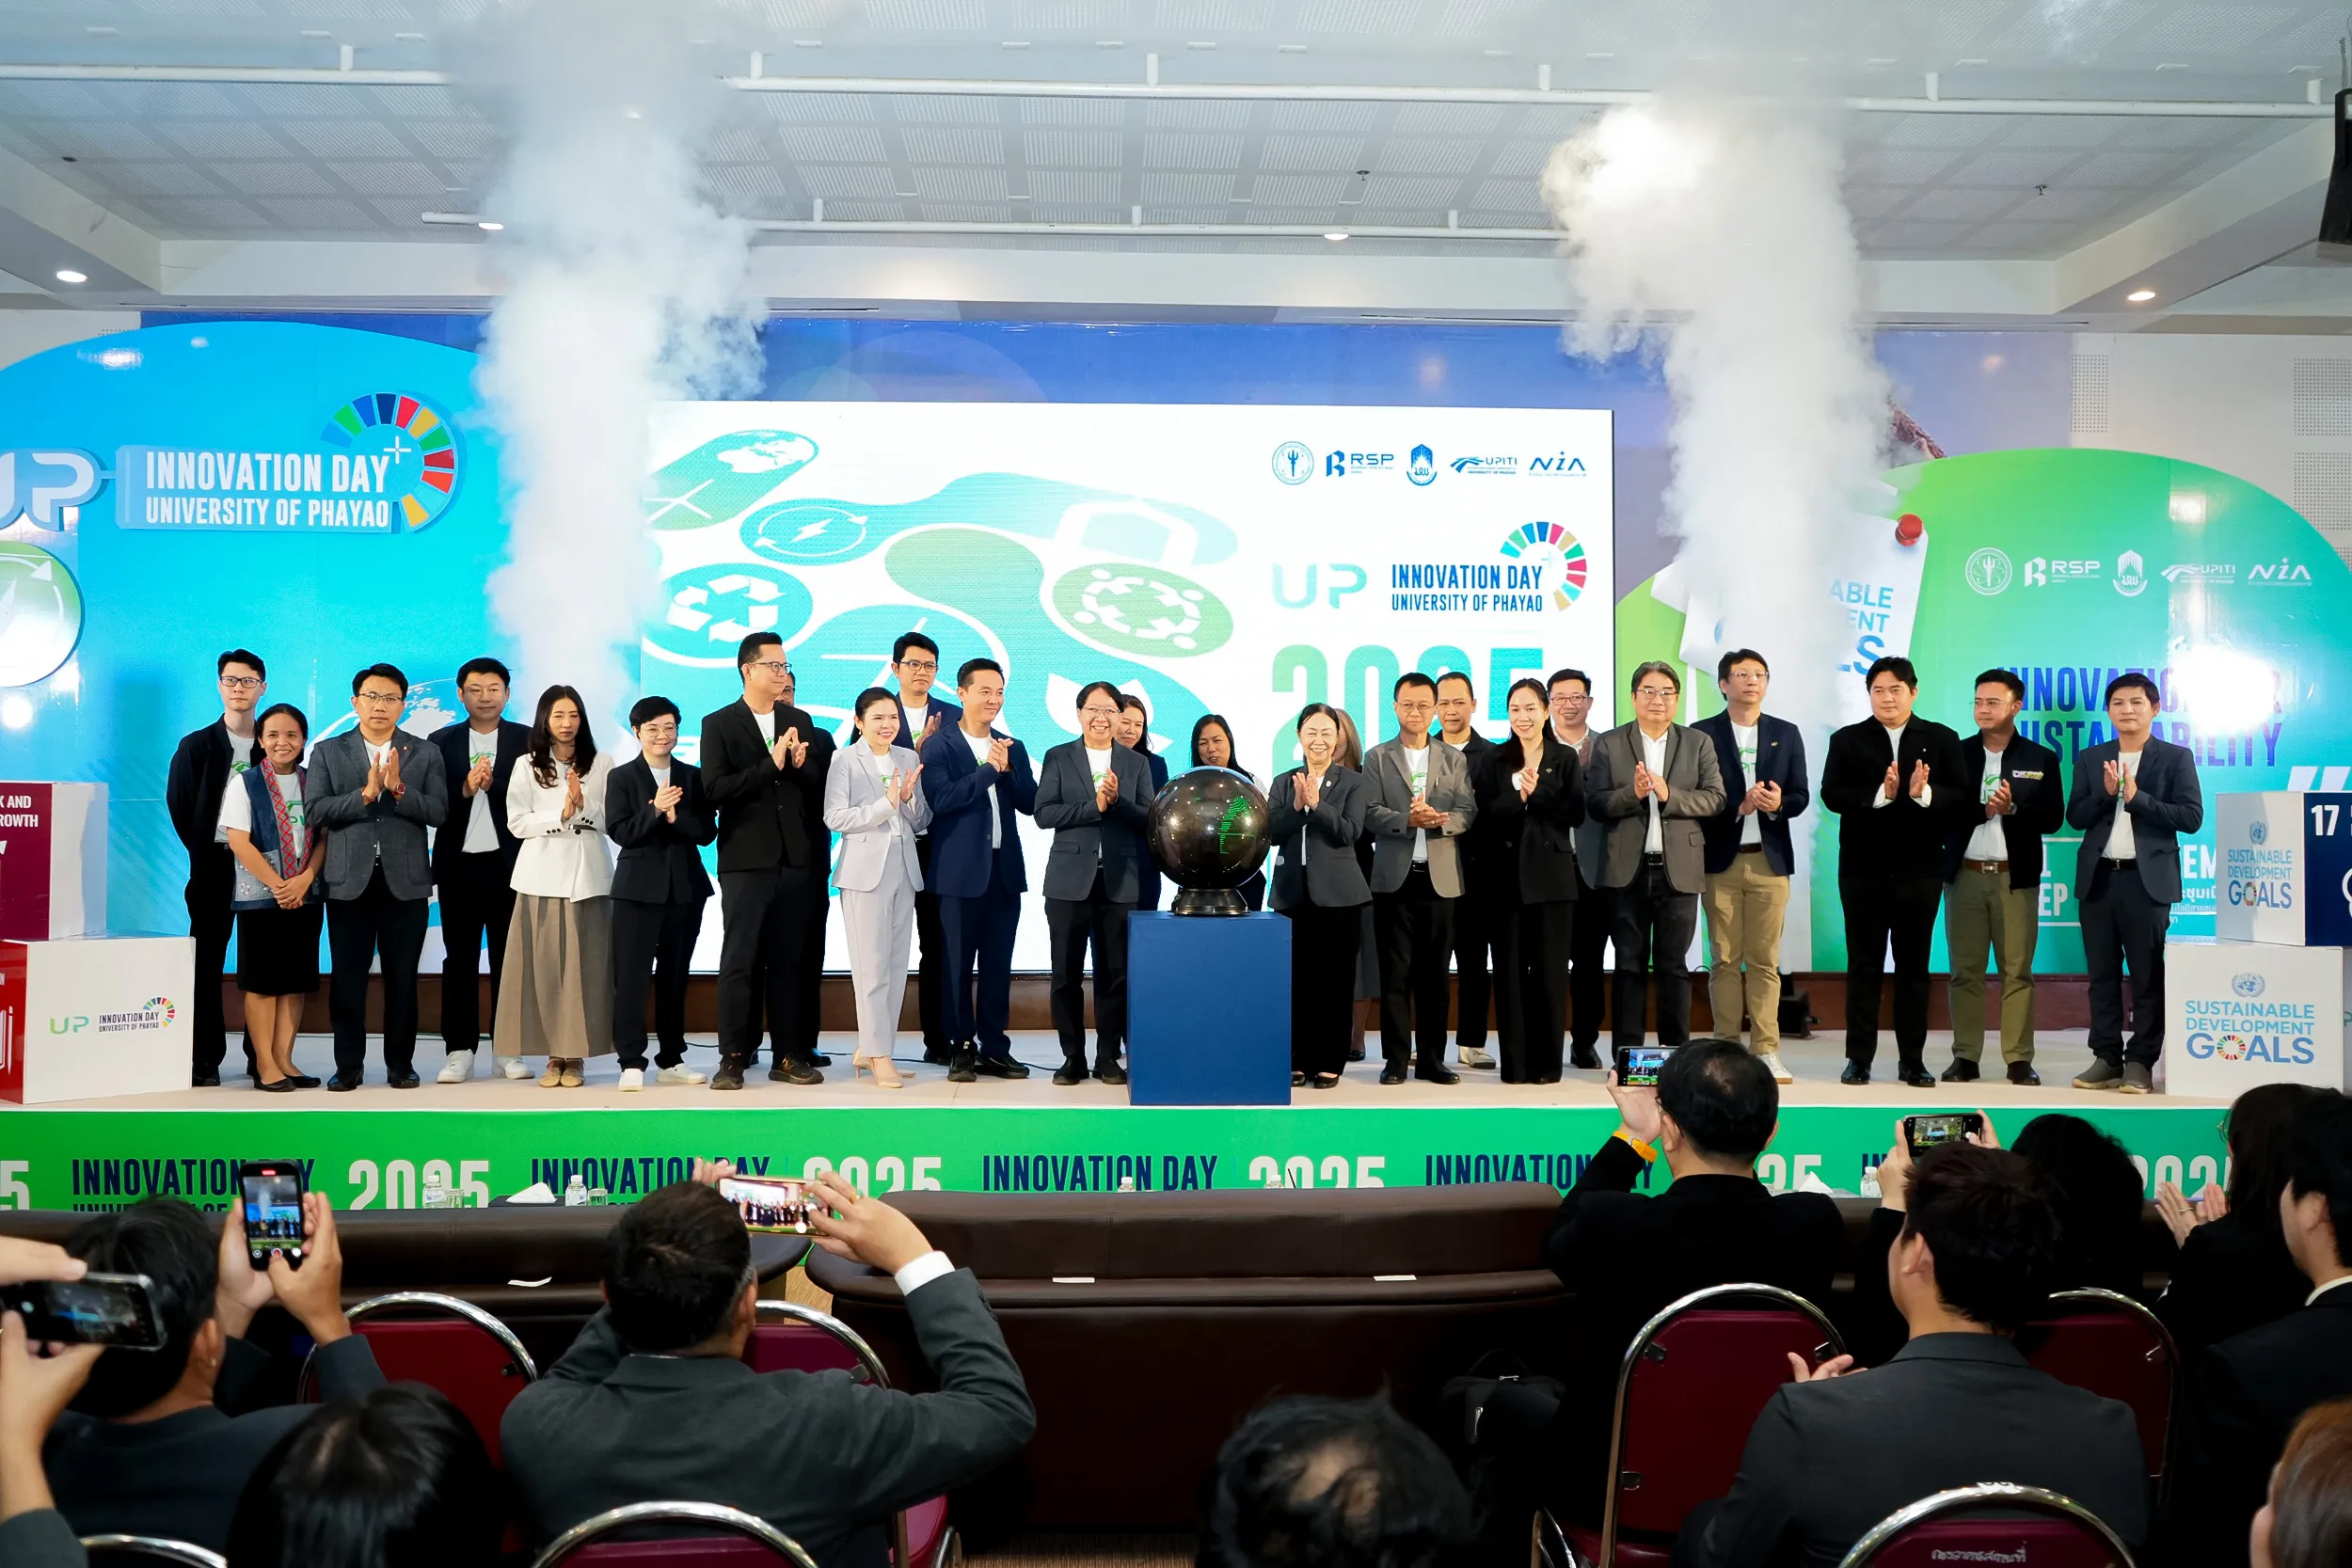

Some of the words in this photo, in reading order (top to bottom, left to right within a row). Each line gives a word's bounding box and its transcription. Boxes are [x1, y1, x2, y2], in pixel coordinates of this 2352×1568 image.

[1350, 453, 1394, 465] RSP
[146, 451, 322, 492] INNOVATION
[331, 454, 390, 493] DAY
[0, 452, 94, 523] P
[146, 496, 270, 525] UNIVERSITY
[276, 499, 301, 526] OF
[308, 499, 389, 528] PHAYAO
[1391, 563, 1501, 590] INNOVATION
[1507, 564, 1543, 590] DAY
[2051, 560, 2101, 575] RSP
[1272, 562, 1368, 610] UP
[1391, 594, 1469, 611] UNIVERSITY
[1473, 594, 1488, 611] OF
[1493, 594, 1543, 612] PHAYAO
[7, 795, 32, 809] AND
[2311, 804, 2340, 836] 17
[2227, 848, 2293, 864] SUSTAINABLE
[2227, 864, 2293, 880] DEVELOPMENT
[2228, 879, 2293, 910] GOALS
[2185, 1000, 2315, 1020] SUSTAINABLE
[50, 1016, 90, 1035] UP
[99, 1012, 143, 1024] INNOVATION
[145, 1011, 160, 1022] DAY
[99, 1023, 131, 1033] UNIVERSITY
[2185, 1017, 2315, 1036] DEVELOPMENT
[2186, 1032, 2315, 1065] GOALS
[982, 1154, 1152, 1192] INNOVATION
[1163, 1155, 1217, 1191] DAY
